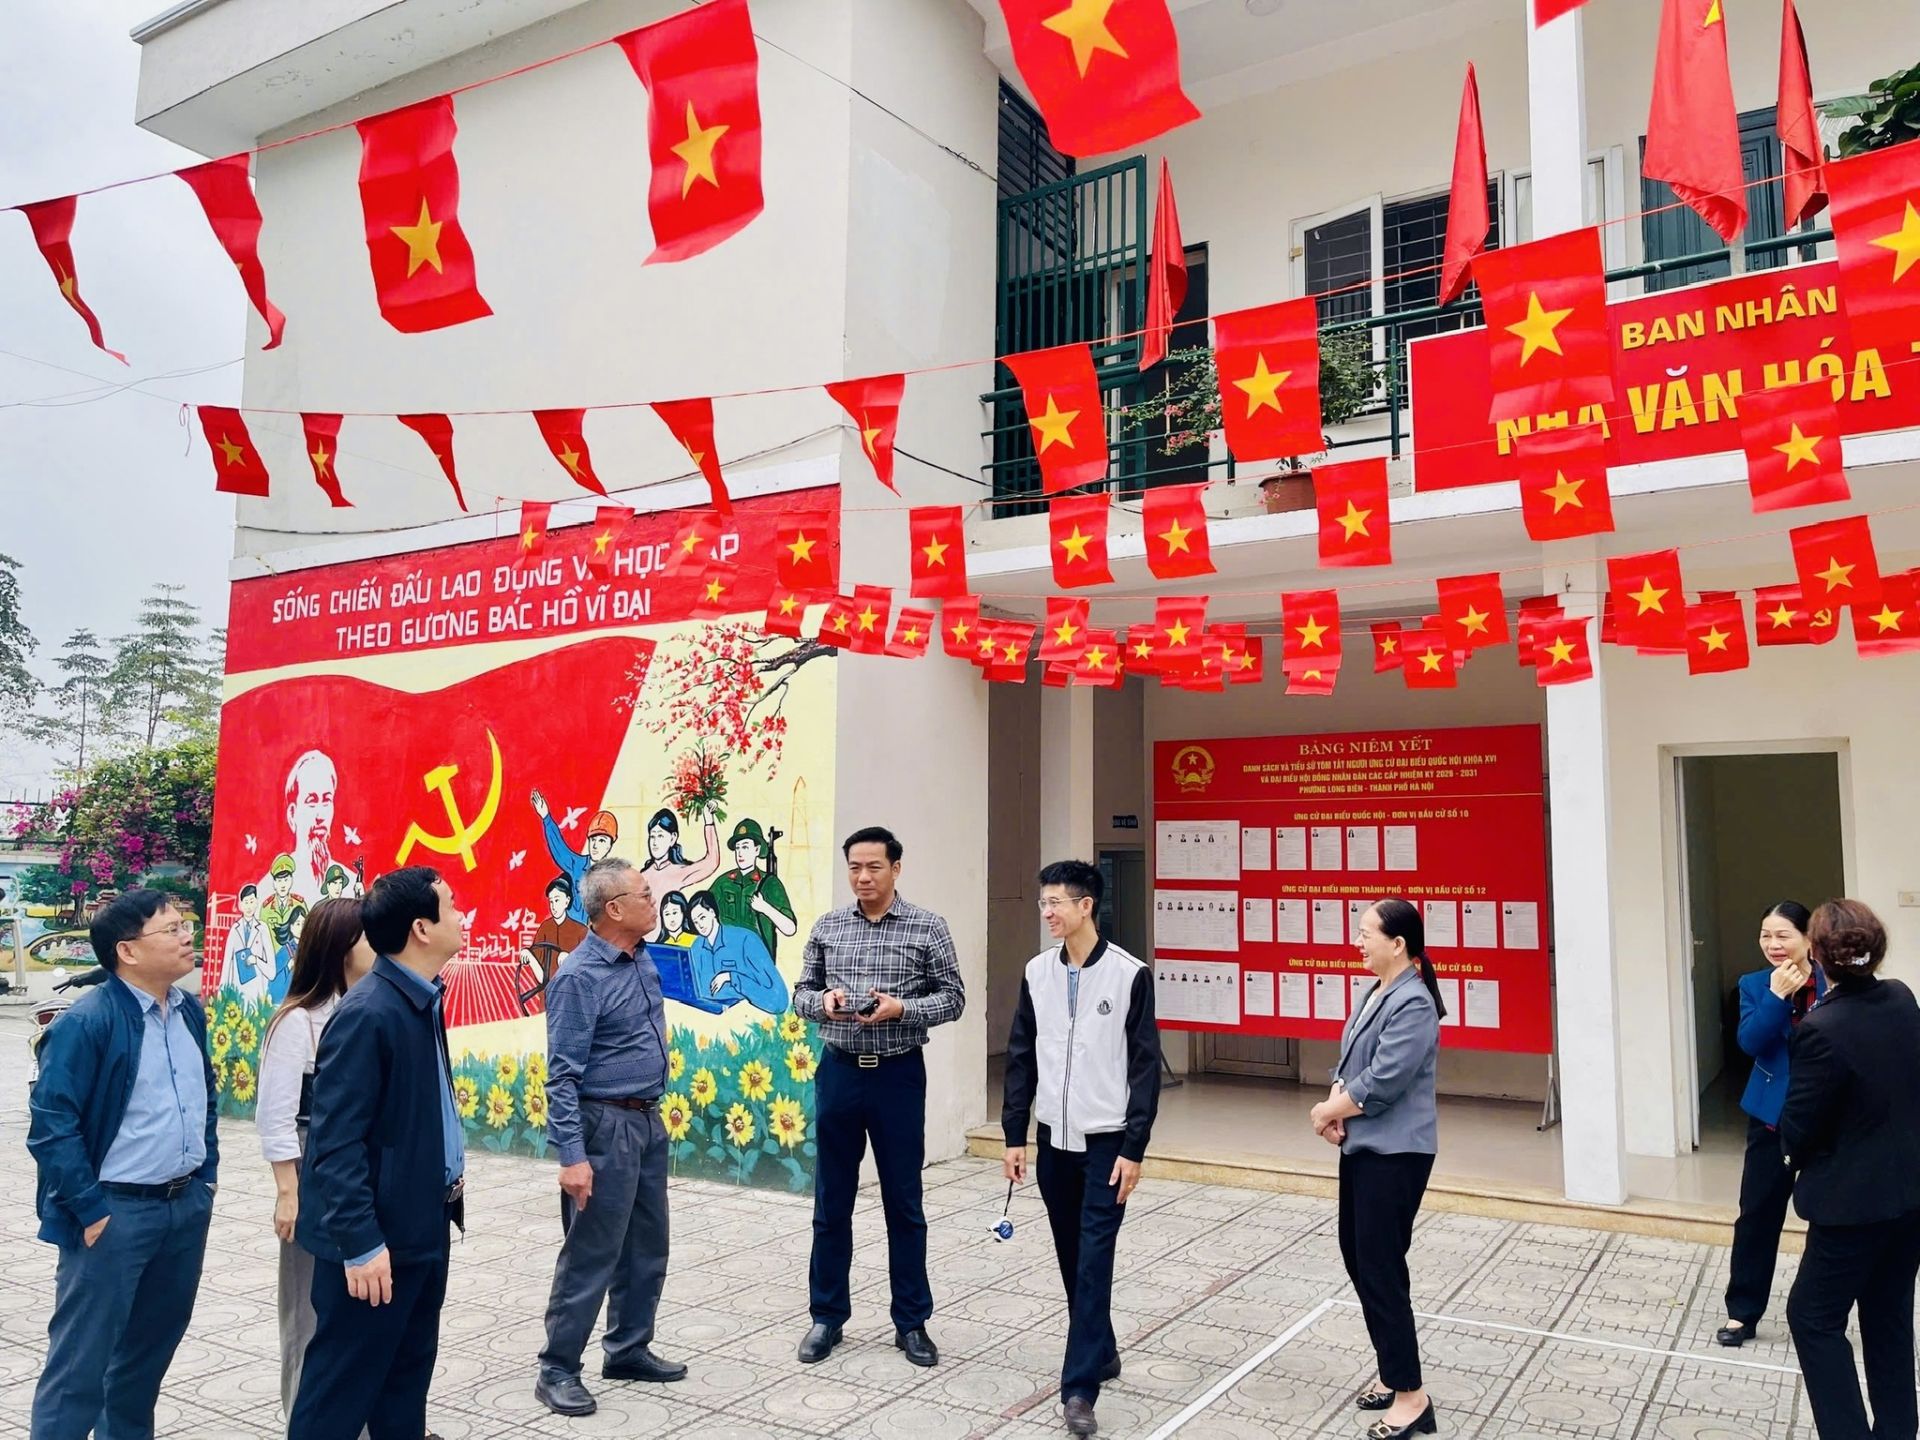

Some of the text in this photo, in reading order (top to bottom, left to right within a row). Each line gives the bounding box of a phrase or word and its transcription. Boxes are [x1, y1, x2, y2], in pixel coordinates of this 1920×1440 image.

[1621, 283, 1838, 351] BAN NHÂN
[1626, 364, 1744, 435] VĂN
[272, 585, 321, 625] SỐNG
[329, 575, 383, 615] CHIẾN
[390, 568, 432, 608] ĐẤU
[440, 569, 482, 601] LAO
[614, 542, 671, 579] HỌC
[336, 583, 651, 652] THEO GƯƠNG BÁC HỒ VĨ ĐẠI
[1398, 734, 1433, 752] YẾT
[1243, 764, 1261, 773] DANH
[1484, 754, 1497, 764] XVI
[1460, 768, 1478, 777] 2031
[1327, 784, 1346, 793] LONG
[1421, 781, 1434, 791] NỘI
[1459, 809, 1469, 818] 10
[1476, 886, 1486, 894] 12
[1473, 965, 1484, 973] 03
